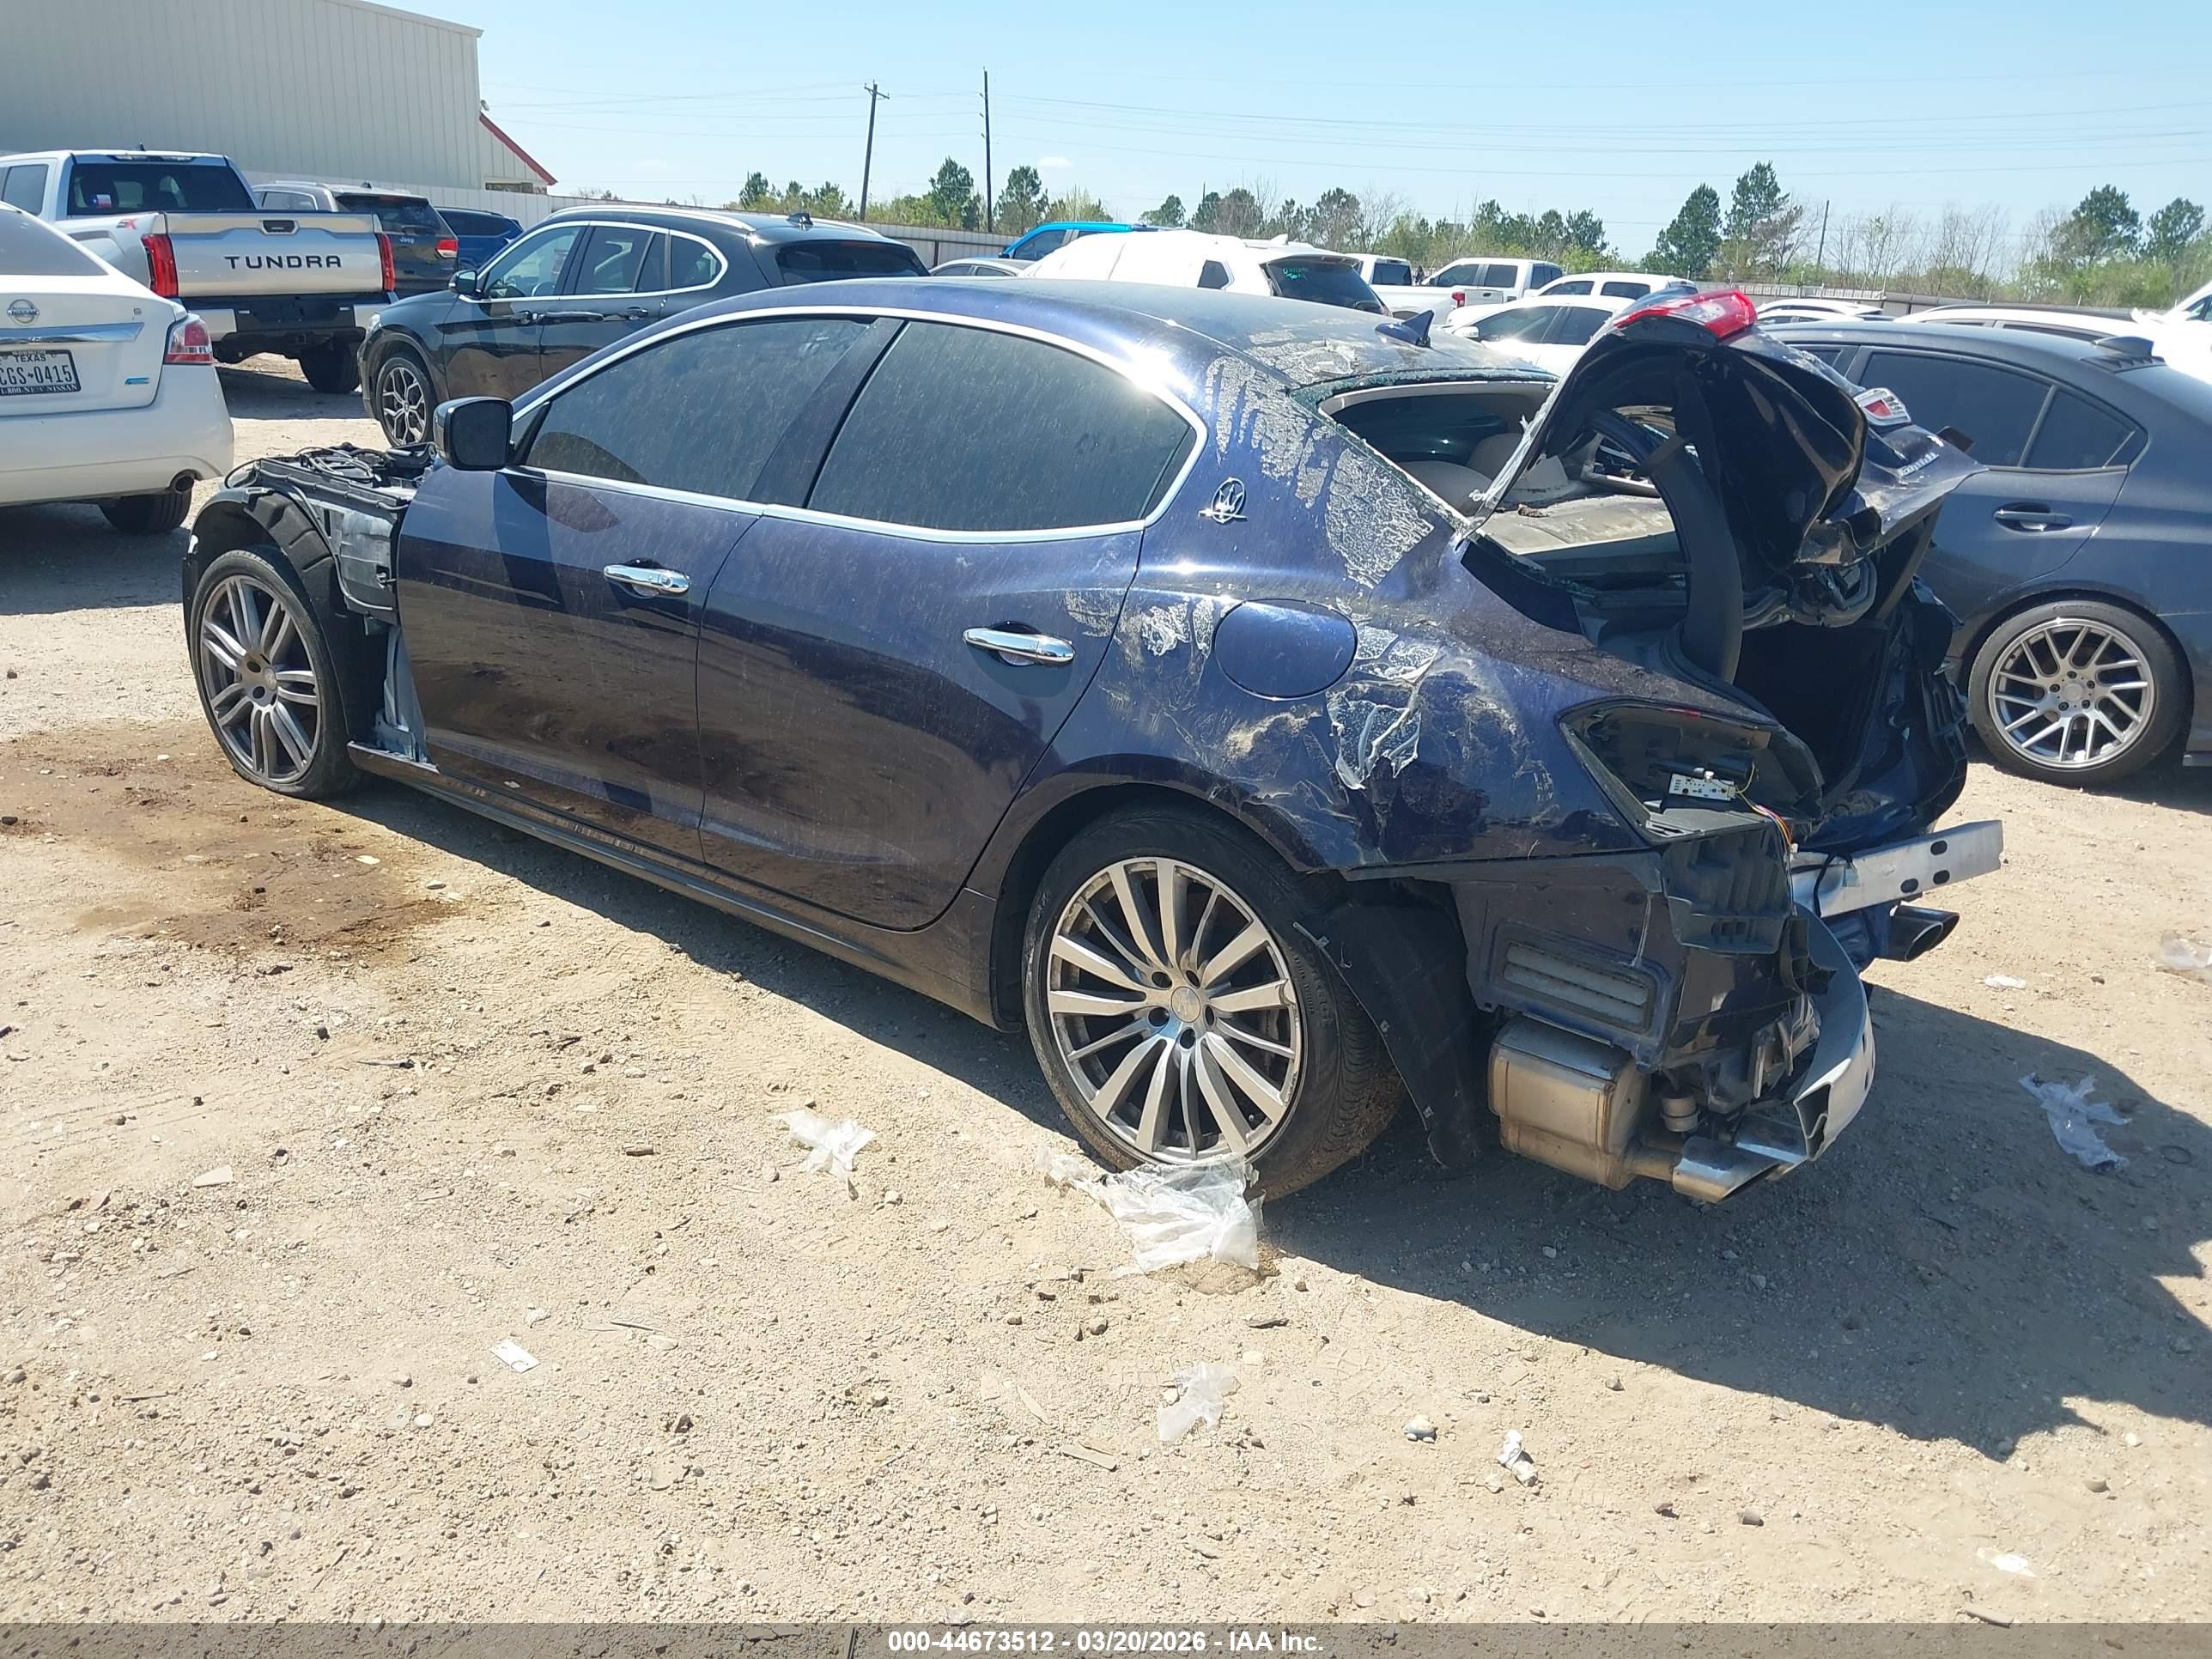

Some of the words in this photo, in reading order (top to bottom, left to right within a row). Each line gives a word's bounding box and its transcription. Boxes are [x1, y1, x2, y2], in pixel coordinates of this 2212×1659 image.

[399, 236, 415, 245] Jeep
[224, 255, 342, 269] TUNDRA
[13, 354, 46, 362] TEXAS
